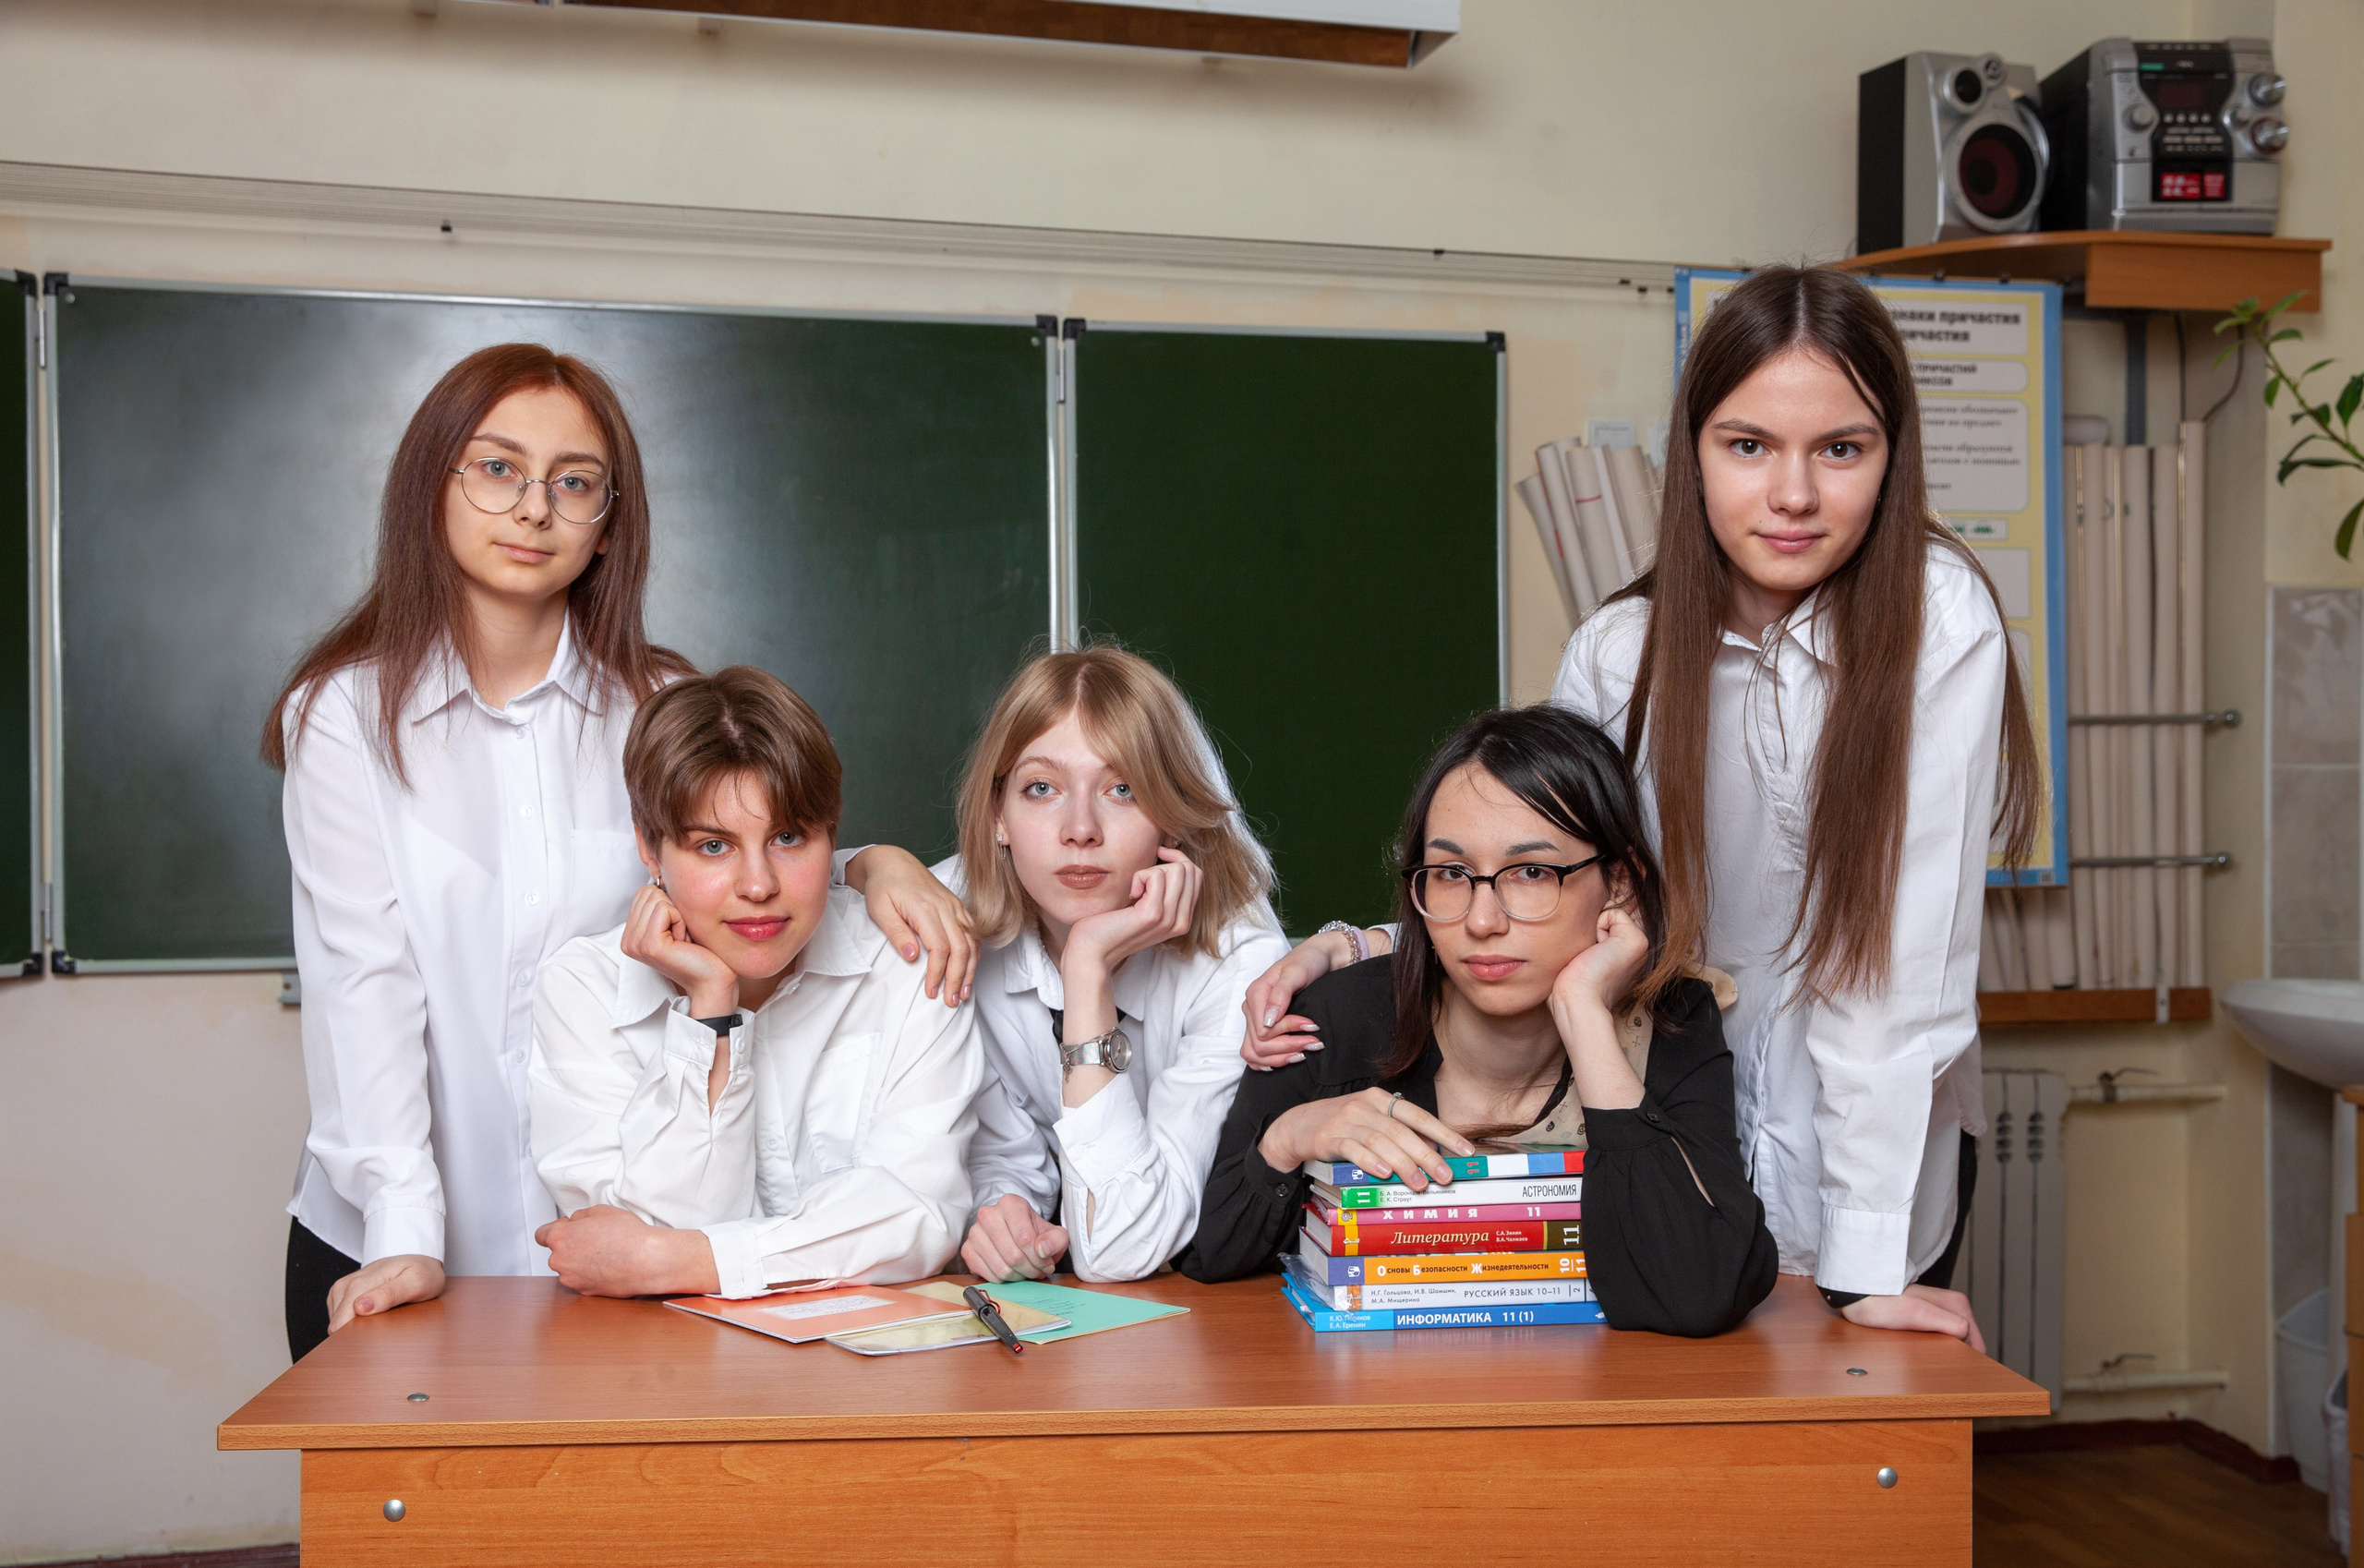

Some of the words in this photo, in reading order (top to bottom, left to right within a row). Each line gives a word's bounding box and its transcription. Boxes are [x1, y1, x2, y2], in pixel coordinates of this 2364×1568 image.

[1939, 311, 2020, 325] причастия
[1466, 1162, 1479, 1175] 11
[1357, 1191, 1370, 1204] 11
[1522, 1185, 1577, 1197] АСТРОНОМИЯ
[1526, 1206, 1540, 1217] 11
[1391, 1231, 1490, 1246] Литература
[1562, 1224, 1580, 1246] 11
[1377, 1265, 1410, 1276] Основы
[1413, 1264, 1468, 1276] Безопасности
[1471, 1262, 1549, 1274] Жизнедеятельности
[1559, 1258, 1570, 1273] 10
[1575, 1258, 1586, 1273] 11
[1464, 1288, 1507, 1298] РУССКИЙ
[1509, 1287, 1534, 1297] ЯЗЫК
[1397, 1312, 1492, 1325] ИНФОРМАТИКА
[1502, 1312, 1515, 1322] 11
[1518, 1311, 1534, 1322] (1)
